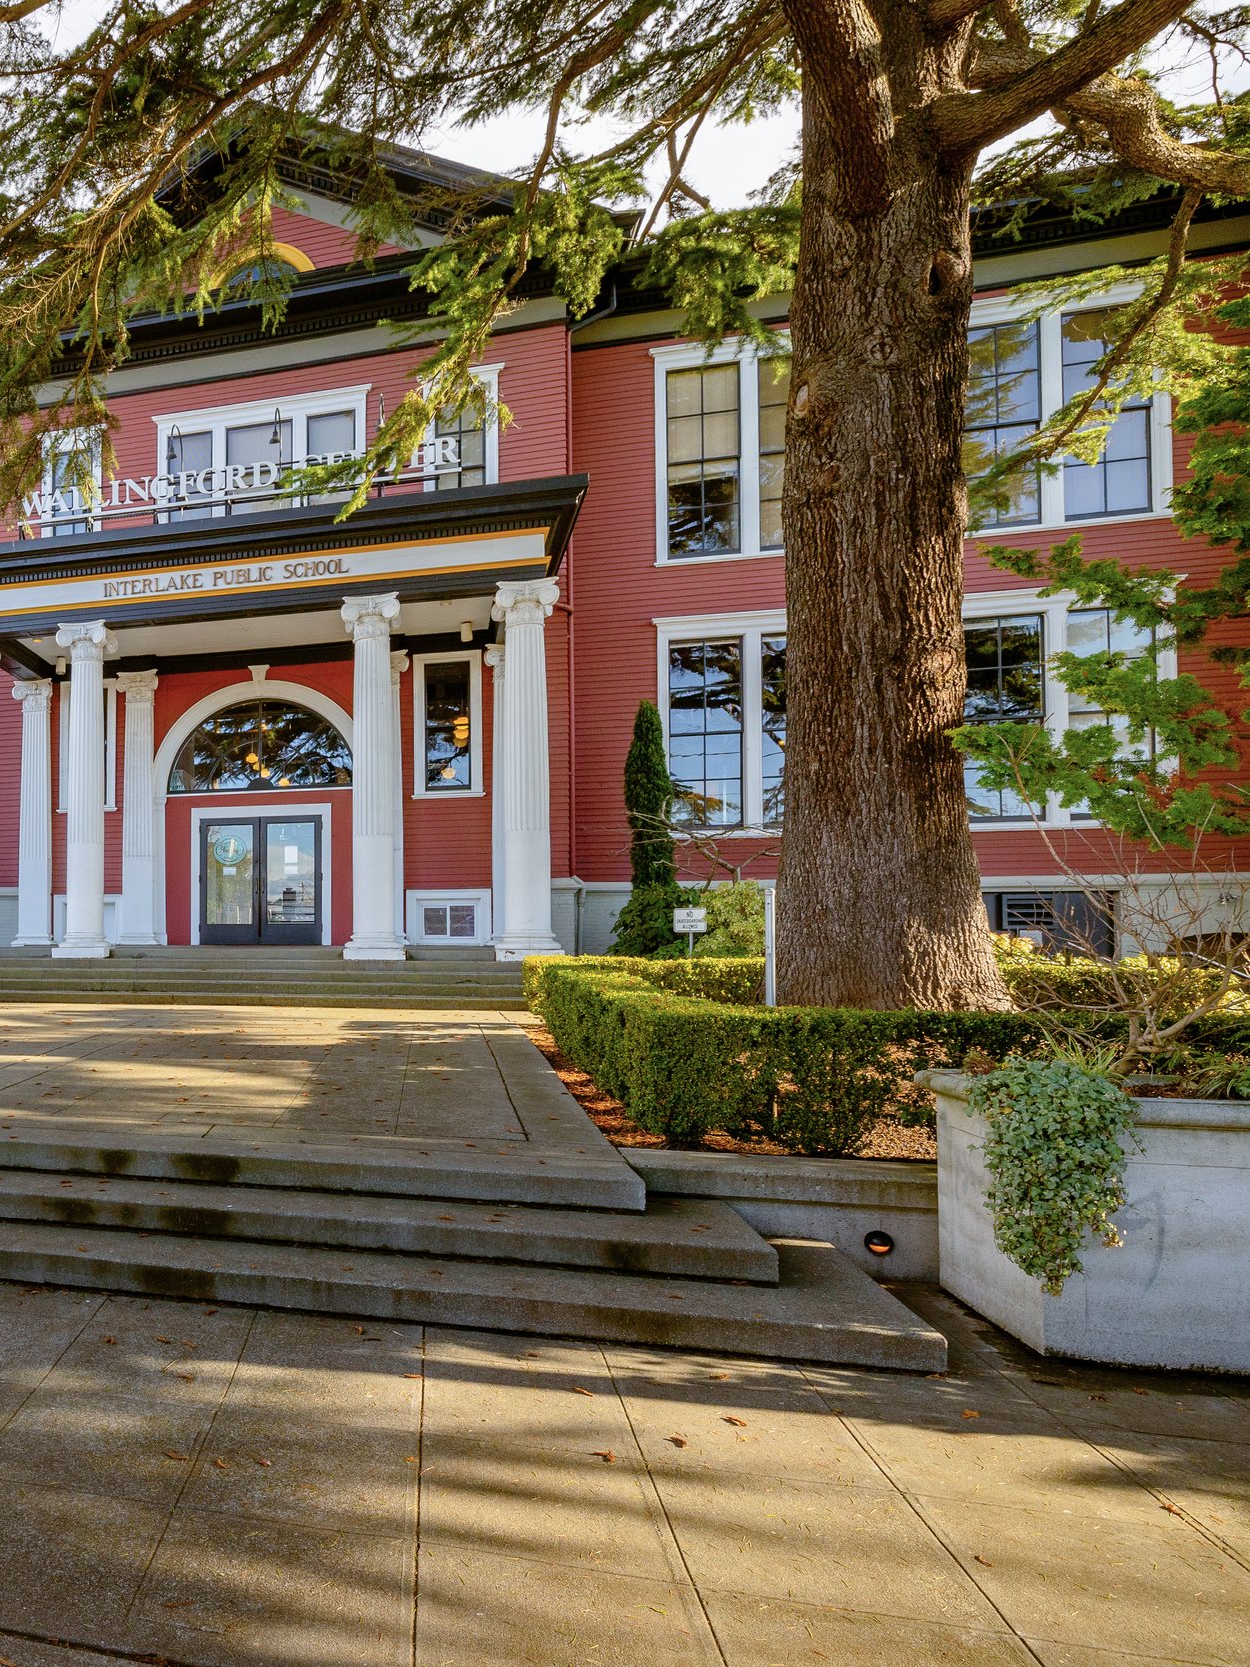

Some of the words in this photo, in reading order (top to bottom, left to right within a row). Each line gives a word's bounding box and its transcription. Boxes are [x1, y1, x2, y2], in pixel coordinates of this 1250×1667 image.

[103, 573, 204, 598] INTERLAKE
[212, 566, 273, 587] PUBLIC
[283, 558, 350, 580] SCHOOL
